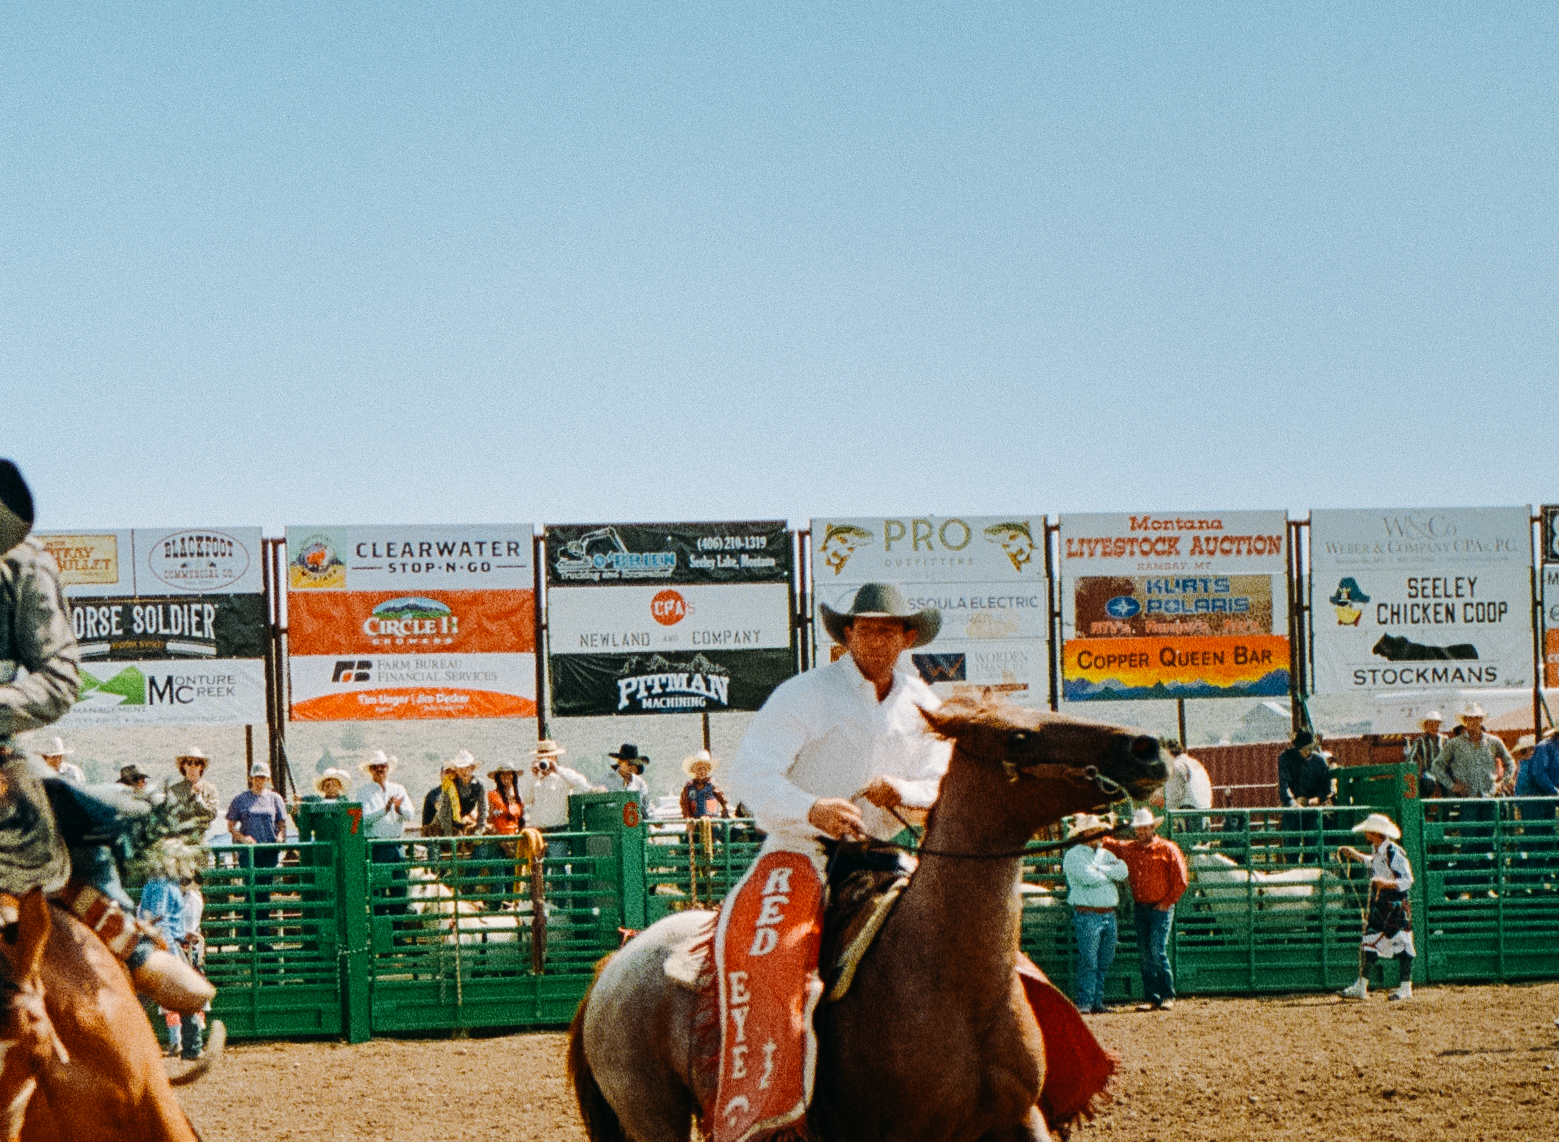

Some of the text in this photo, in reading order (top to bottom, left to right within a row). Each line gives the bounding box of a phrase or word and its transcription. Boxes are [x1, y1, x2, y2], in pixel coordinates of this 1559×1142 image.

[1129, 516, 1224, 531] Montana
[884, 518, 972, 552] PRO
[164, 535, 234, 558] BLACKFOOT
[355, 541, 521, 558] CLEARWATER
[1065, 534, 1283, 559] LIVESTOCK AUCTION
[164, 569, 219, 580] COMMERCIAL
[1146, 577, 1230, 594] KURTS
[1407, 577, 1478, 599] SEELEY
[970, 595, 1039, 609] ELECTRIC
[1146, 597, 1250, 614] POLARIS
[1377, 601, 1508, 625] CHICKEN COOP
[73, 603, 216, 640] ORSE SOLDIER
[362, 616, 459, 637] CIRCLE H
[580, 632, 651, 648] NEWLAND
[691, 629, 761, 646] COMPANY
[377, 659, 462, 670] FARM BUREAU
[1077, 646, 1273, 669] COPPER QUEEN BAR
[377, 670, 498, 682] FINANCIAL SERVICES
[1353, 667, 1497, 686] STOCKMANS
[617, 672, 730, 711] PITMAN
[642, 696, 707, 709] MACHINING
[1404, 773, 1417, 799] 3
[347, 808, 362, 835] 7
[622, 801, 639, 828] 6
[749, 867, 793, 956] RED
[729, 971, 750, 1080] EYE
